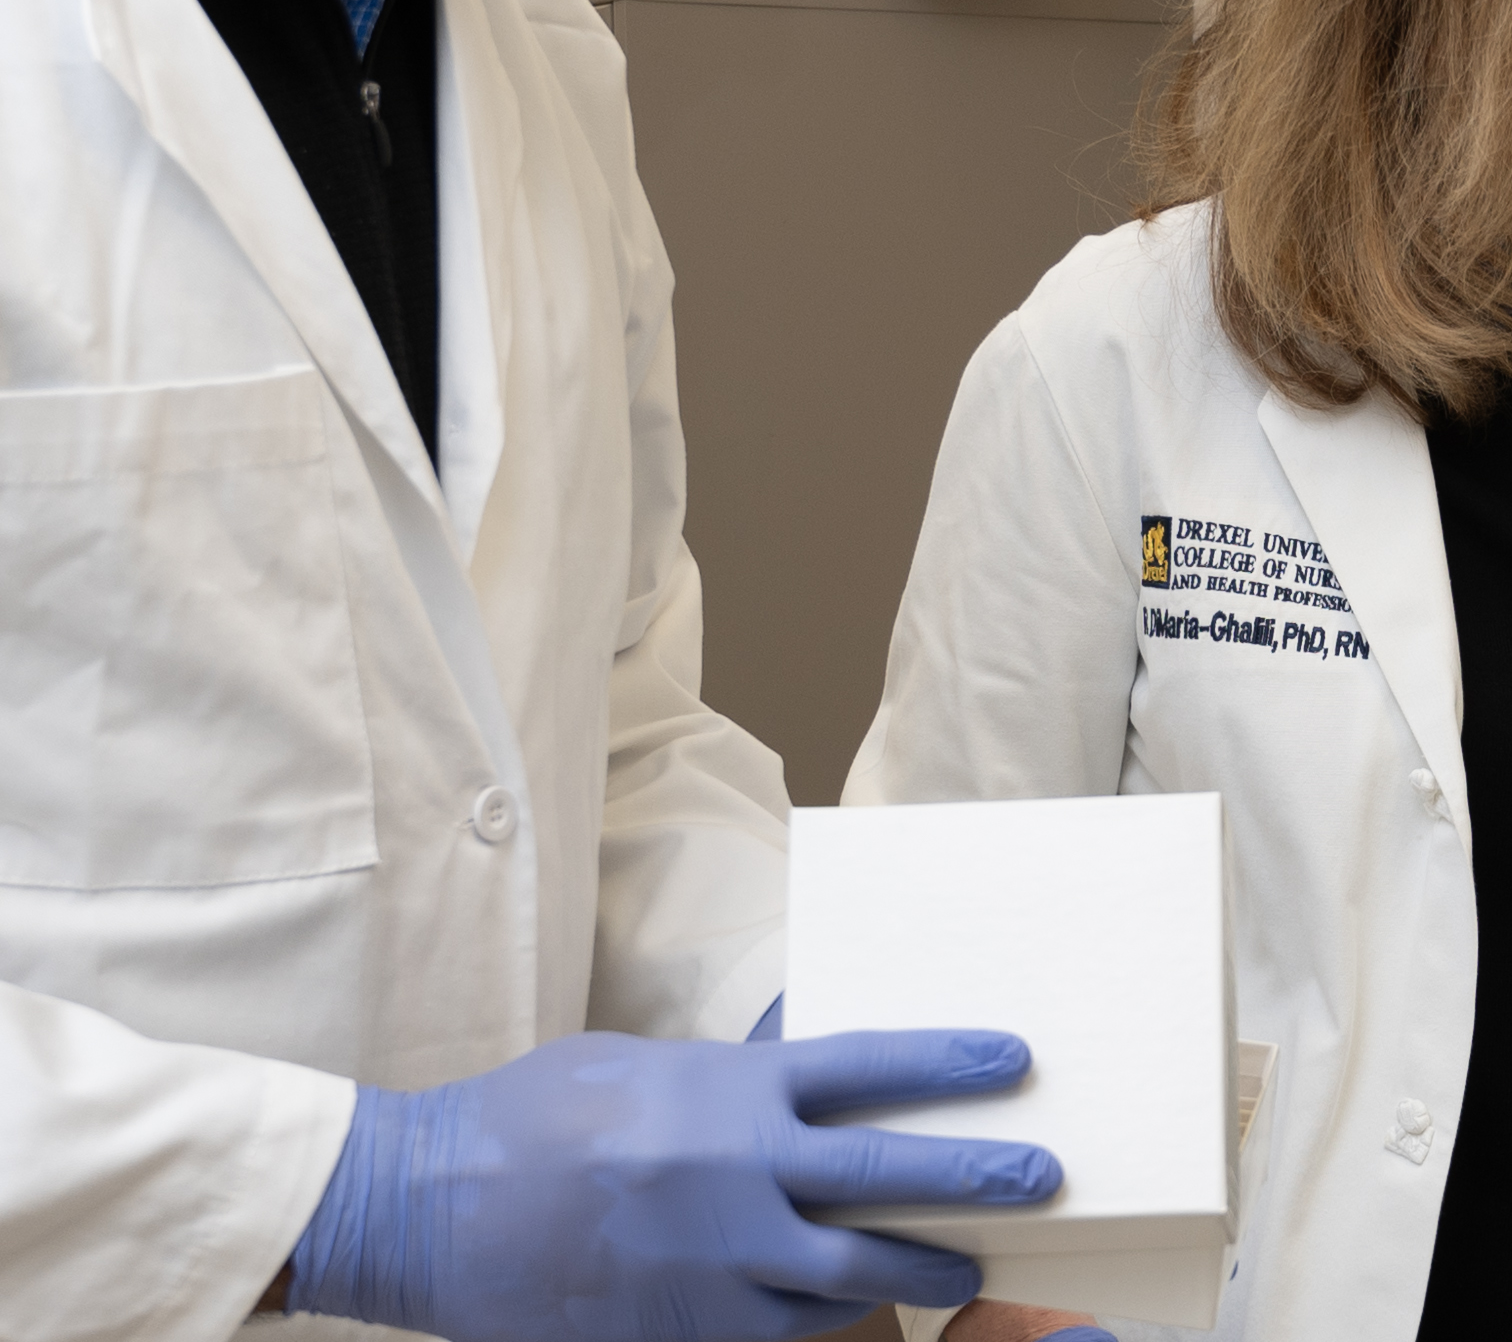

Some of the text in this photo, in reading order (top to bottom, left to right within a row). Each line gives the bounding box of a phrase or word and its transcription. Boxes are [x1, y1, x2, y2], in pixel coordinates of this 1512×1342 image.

[1176, 518, 1254, 548] DREXEL
[1173, 546, 1256, 573] COLLEGE
[1262, 558, 1288, 580] OF
[1171, 574, 1353, 613] AND HEALTH PROFESSIO
[1282, 621, 1329, 660] PhD,
[1335, 630, 1370, 660] RN
